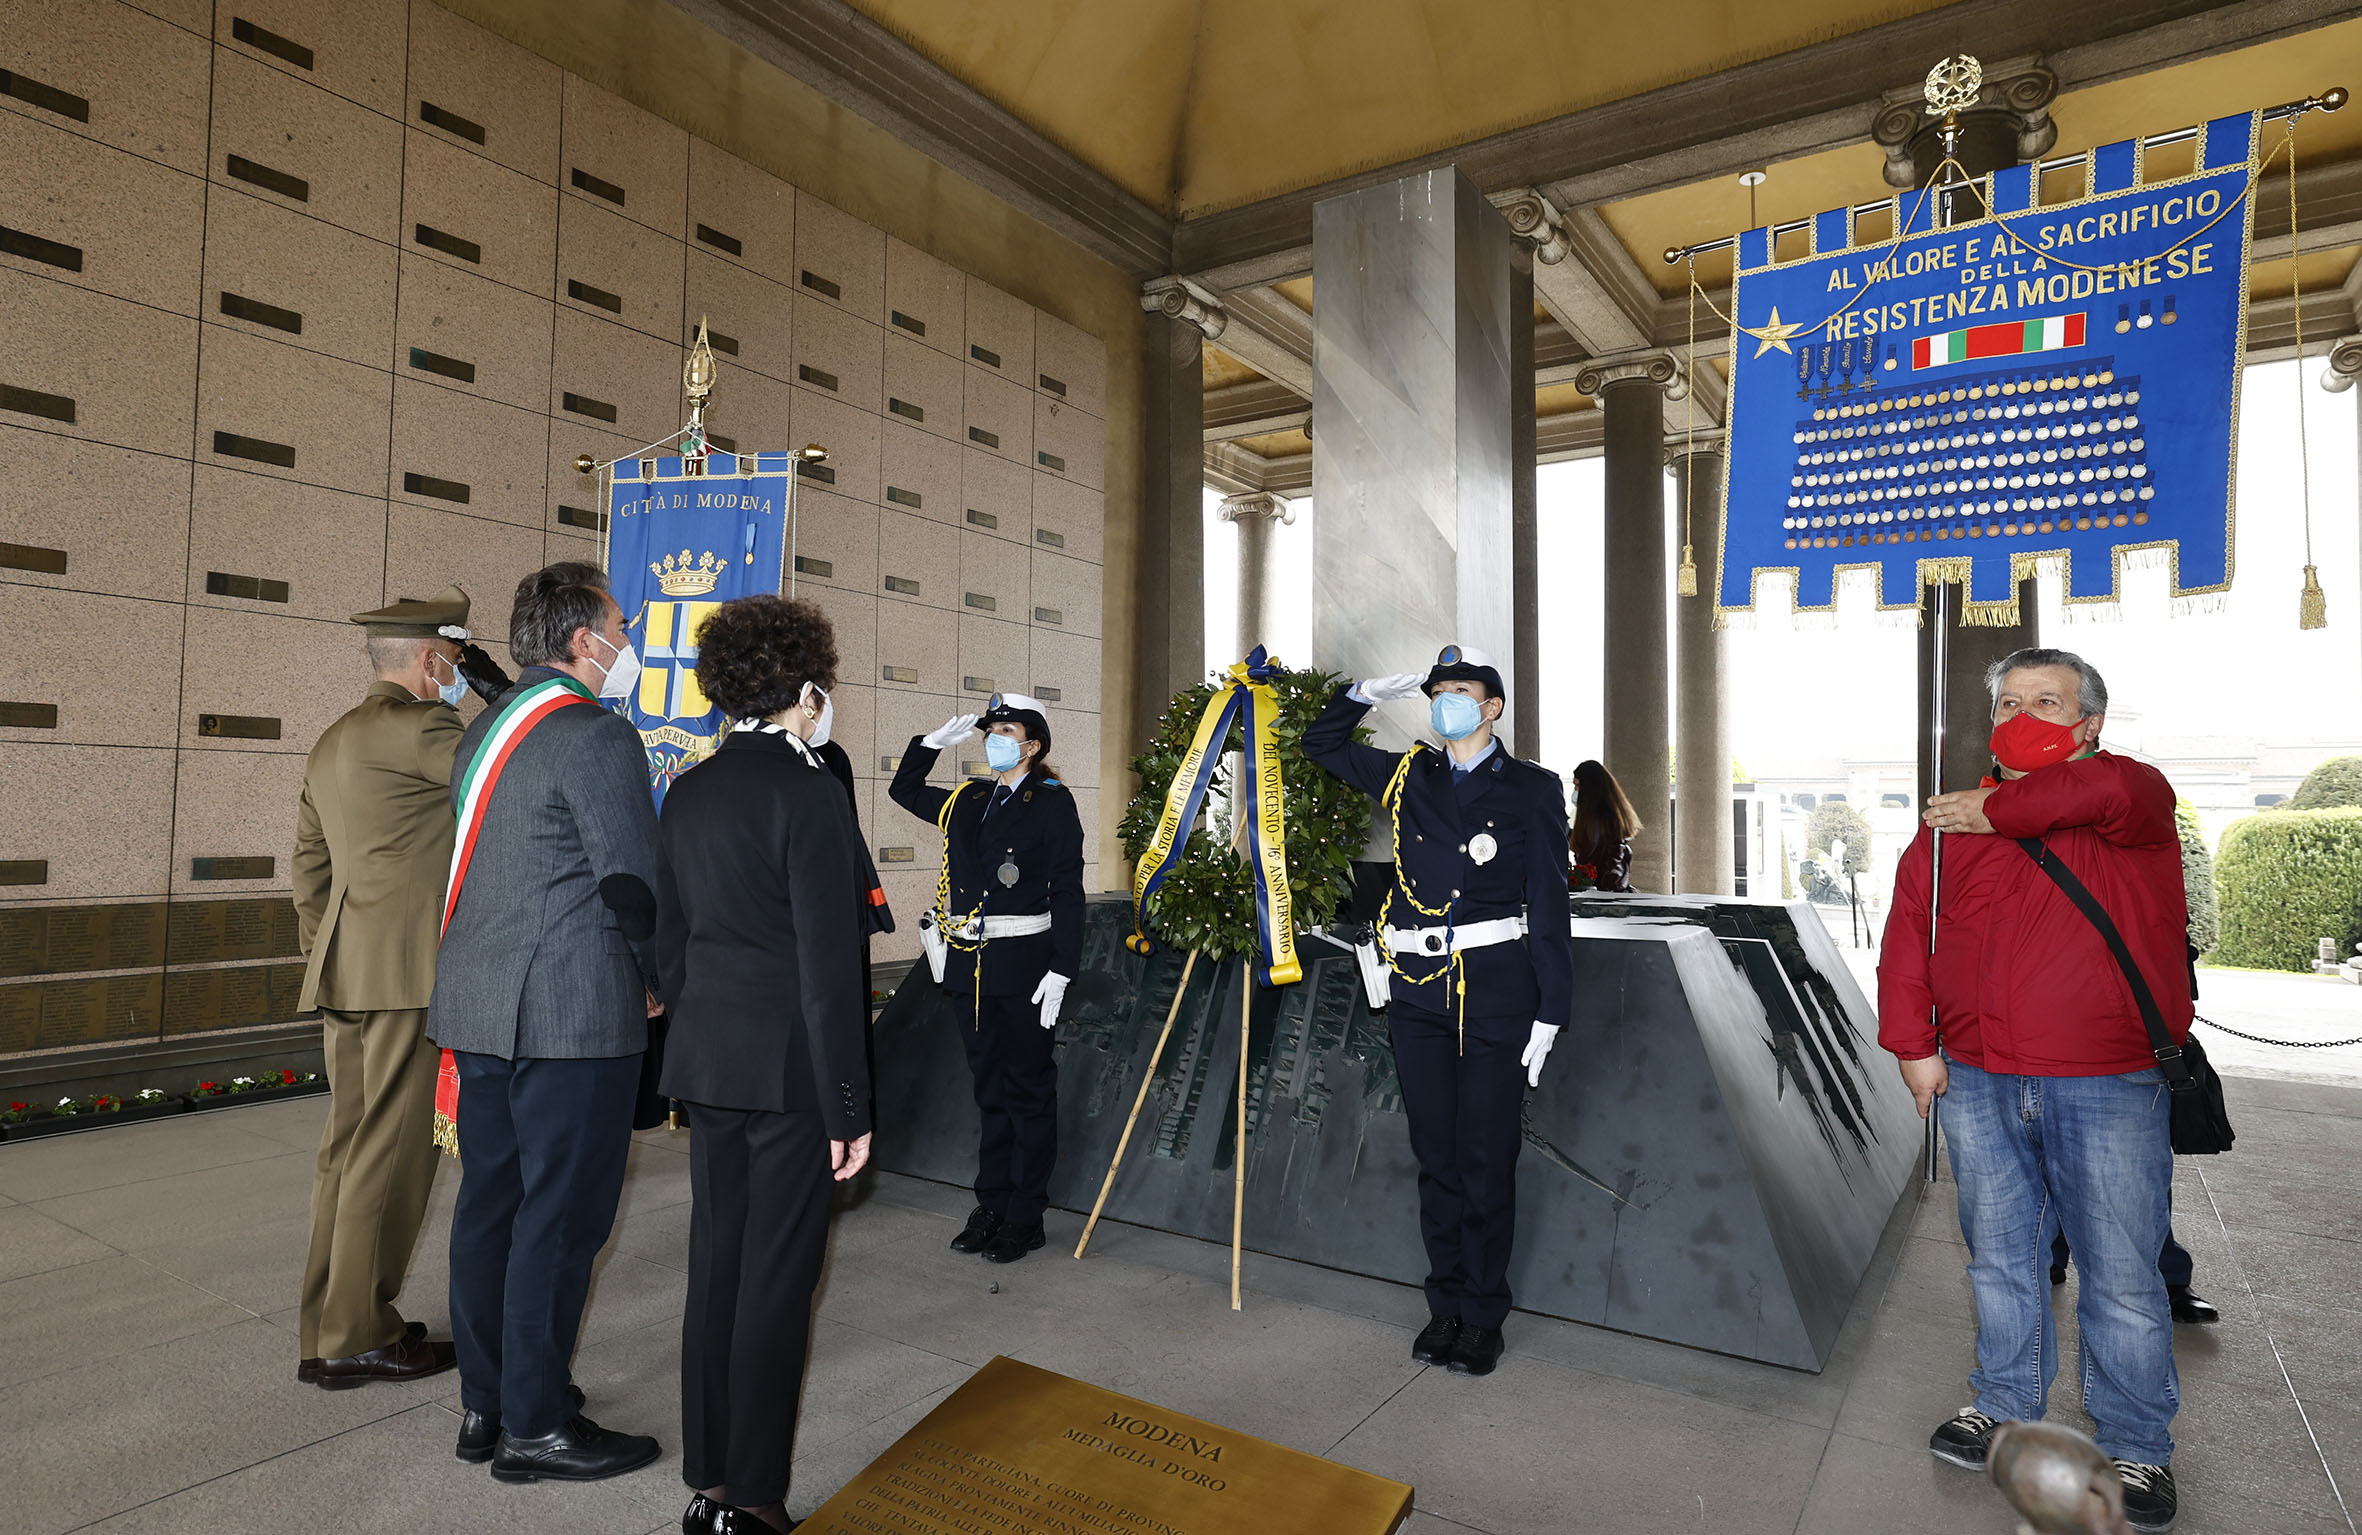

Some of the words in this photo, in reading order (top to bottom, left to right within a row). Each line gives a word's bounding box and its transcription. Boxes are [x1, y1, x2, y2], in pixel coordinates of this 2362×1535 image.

[1827, 268, 1857, 292] AL
[1863, 244, 1957, 284] VALORE
[1965, 238, 1981, 263] E
[1990, 232, 2026, 258] AL
[2038, 189, 2221, 250] SACRIFICIO
[1826, 283, 2009, 342] RESISTENZA
[2017, 243, 2214, 308] MODENESE
[1961, 256, 2047, 284] DELLA
[621, 491, 666, 517] CITTÀ
[673, 494, 688, 509] DI
[697, 493, 772, 515] MODENA
[1177, 746, 1203, 794] MEMORIE
[1263, 743, 1278, 762] DEL
[1170, 806, 1181, 815] E
[1174, 793, 1185, 808] LE
[1263, 766, 1280, 833] NOVECENTO
[1149, 851, 1165, 864] LA
[1157, 815, 1178, 852] STORIA
[1267, 844, 1281, 861] 76°
[1139, 863, 1156, 881] PER
[1269, 865, 1291, 954] ANNIVERSARIO
[1063, 1428, 1157, 1469] MEDAGLIA
[1162, 1461, 1227, 1492] D'ORO
[1102, 1411, 1223, 1463] MODENA
[855, 1498, 881, 1513] CHE
[883, 1508, 938, 1535] TENTAVA
[869, 1485, 905, 1505] DELLA
[952, 1519, 983, 1534] ALLE
[884, 1472, 953, 1505] TRADIZIONI
[962, 1503, 979, 1516] LA
[980, 1510, 1012, 1529] FEDE
[927, 1455, 981, 1481] COCENTE
[982, 1474, 1034, 1498] DOLORE
[1032, 1494, 1043, 1503] E
[1044, 1500, 1141, 1535] ALL'UMILIAZIO
[949, 1480, 1042, 1521] PRONTAMENTE
[1043, 1515, 1094, 1535] RINNO
[1047, 1482, 1095, 1505] CUORE
[1096, 1500, 1115, 1513] DI
[1117, 1507, 1187, 1535] PROVINC
[842, 1511, 885, 1534] VALORE
